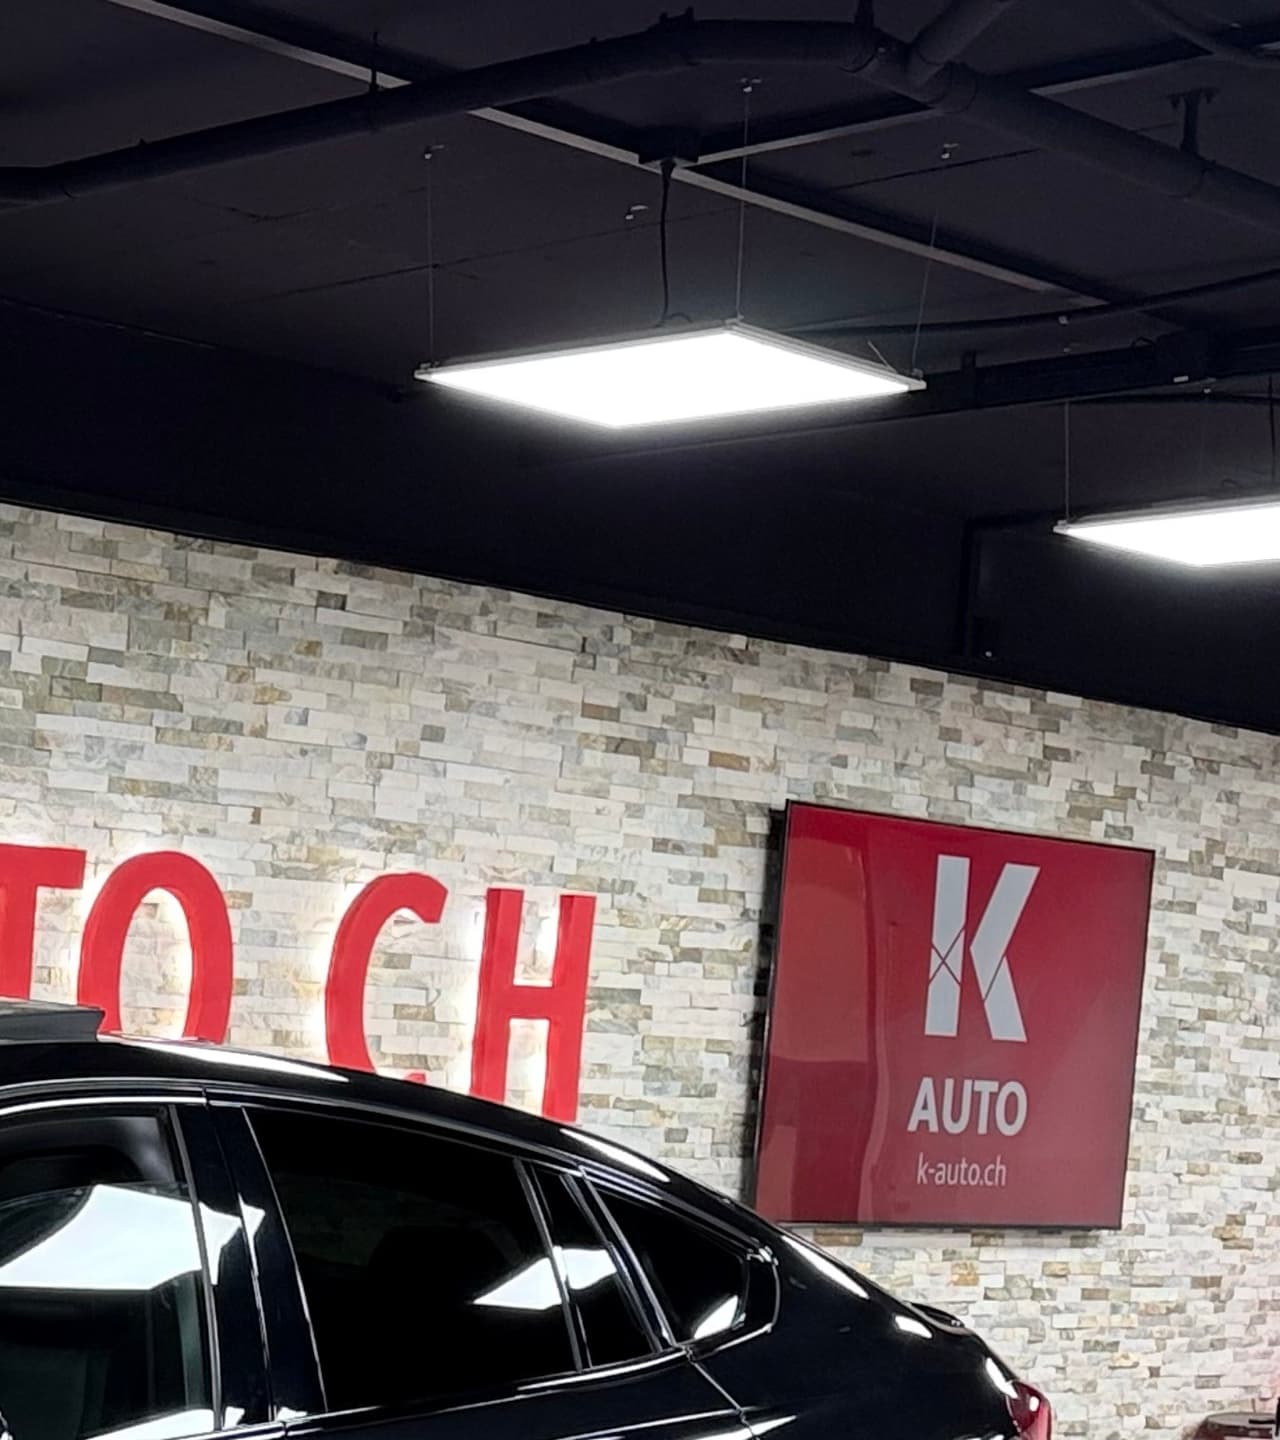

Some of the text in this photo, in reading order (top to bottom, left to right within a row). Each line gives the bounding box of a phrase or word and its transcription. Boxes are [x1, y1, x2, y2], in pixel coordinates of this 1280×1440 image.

[924, 854, 1040, 1042] K
[906, 1076, 1028, 1137] AUTO
[916, 1152, 1007, 1187] k-auto.ch
